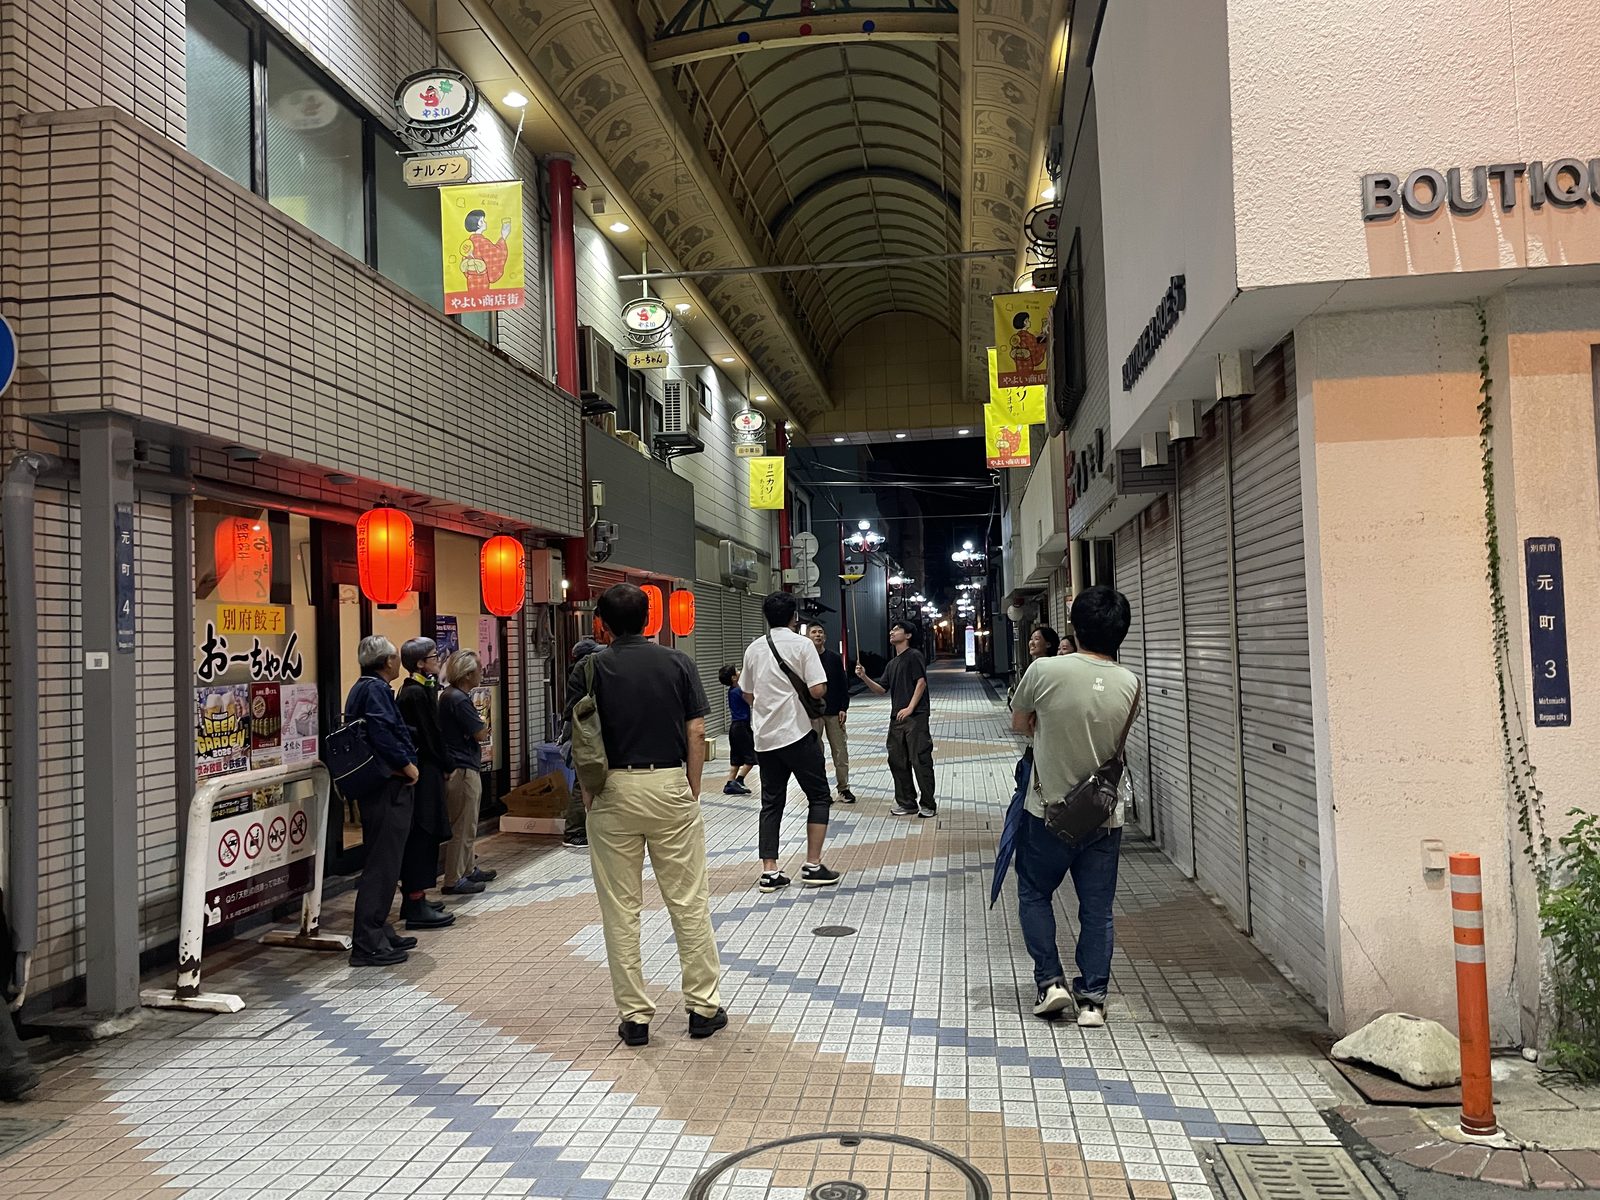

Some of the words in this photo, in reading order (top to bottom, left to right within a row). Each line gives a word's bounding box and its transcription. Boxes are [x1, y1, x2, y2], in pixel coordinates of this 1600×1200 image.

[422, 107, 450, 118] やよい
[412, 163, 461, 177] ナルダン
[451, 293, 519, 309] やよい商店街
[633, 354, 663, 365] おーちゃん
[223, 608, 281, 631] 別府餃子
[198, 622, 303, 680] おーちゃん
[204, 714, 236, 734] BEER
[197, 728, 246, 754] GARDEN
